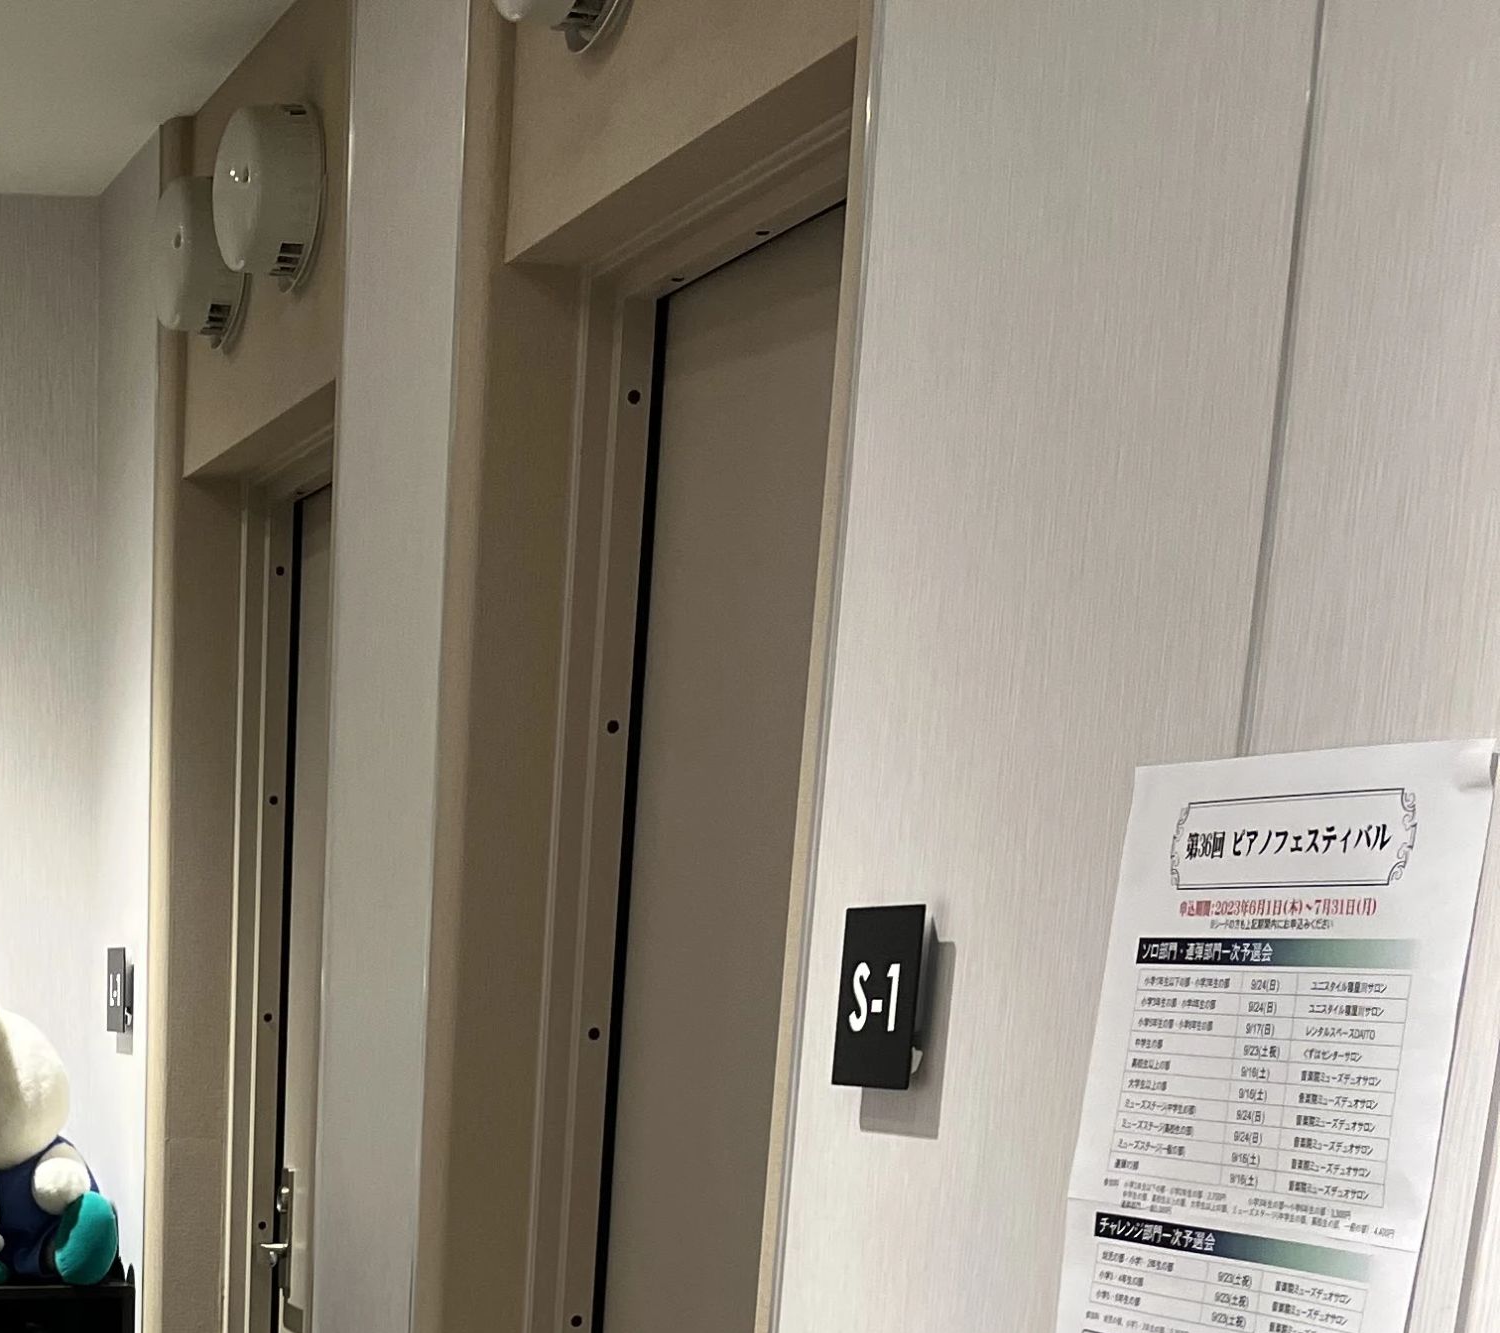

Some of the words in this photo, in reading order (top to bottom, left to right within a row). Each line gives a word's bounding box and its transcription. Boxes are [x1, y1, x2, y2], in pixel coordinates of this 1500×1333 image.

[1185, 831, 1226, 861] 第36回
[1232, 824, 1392, 857] ピアノフェスティバル
[1141, 942, 1274, 963] ソロ部門・連弾部門一次予選会
[849, 962, 901, 1033] S-1
[1099, 1217, 1216, 1251] チャレンジ部門一次予選会
